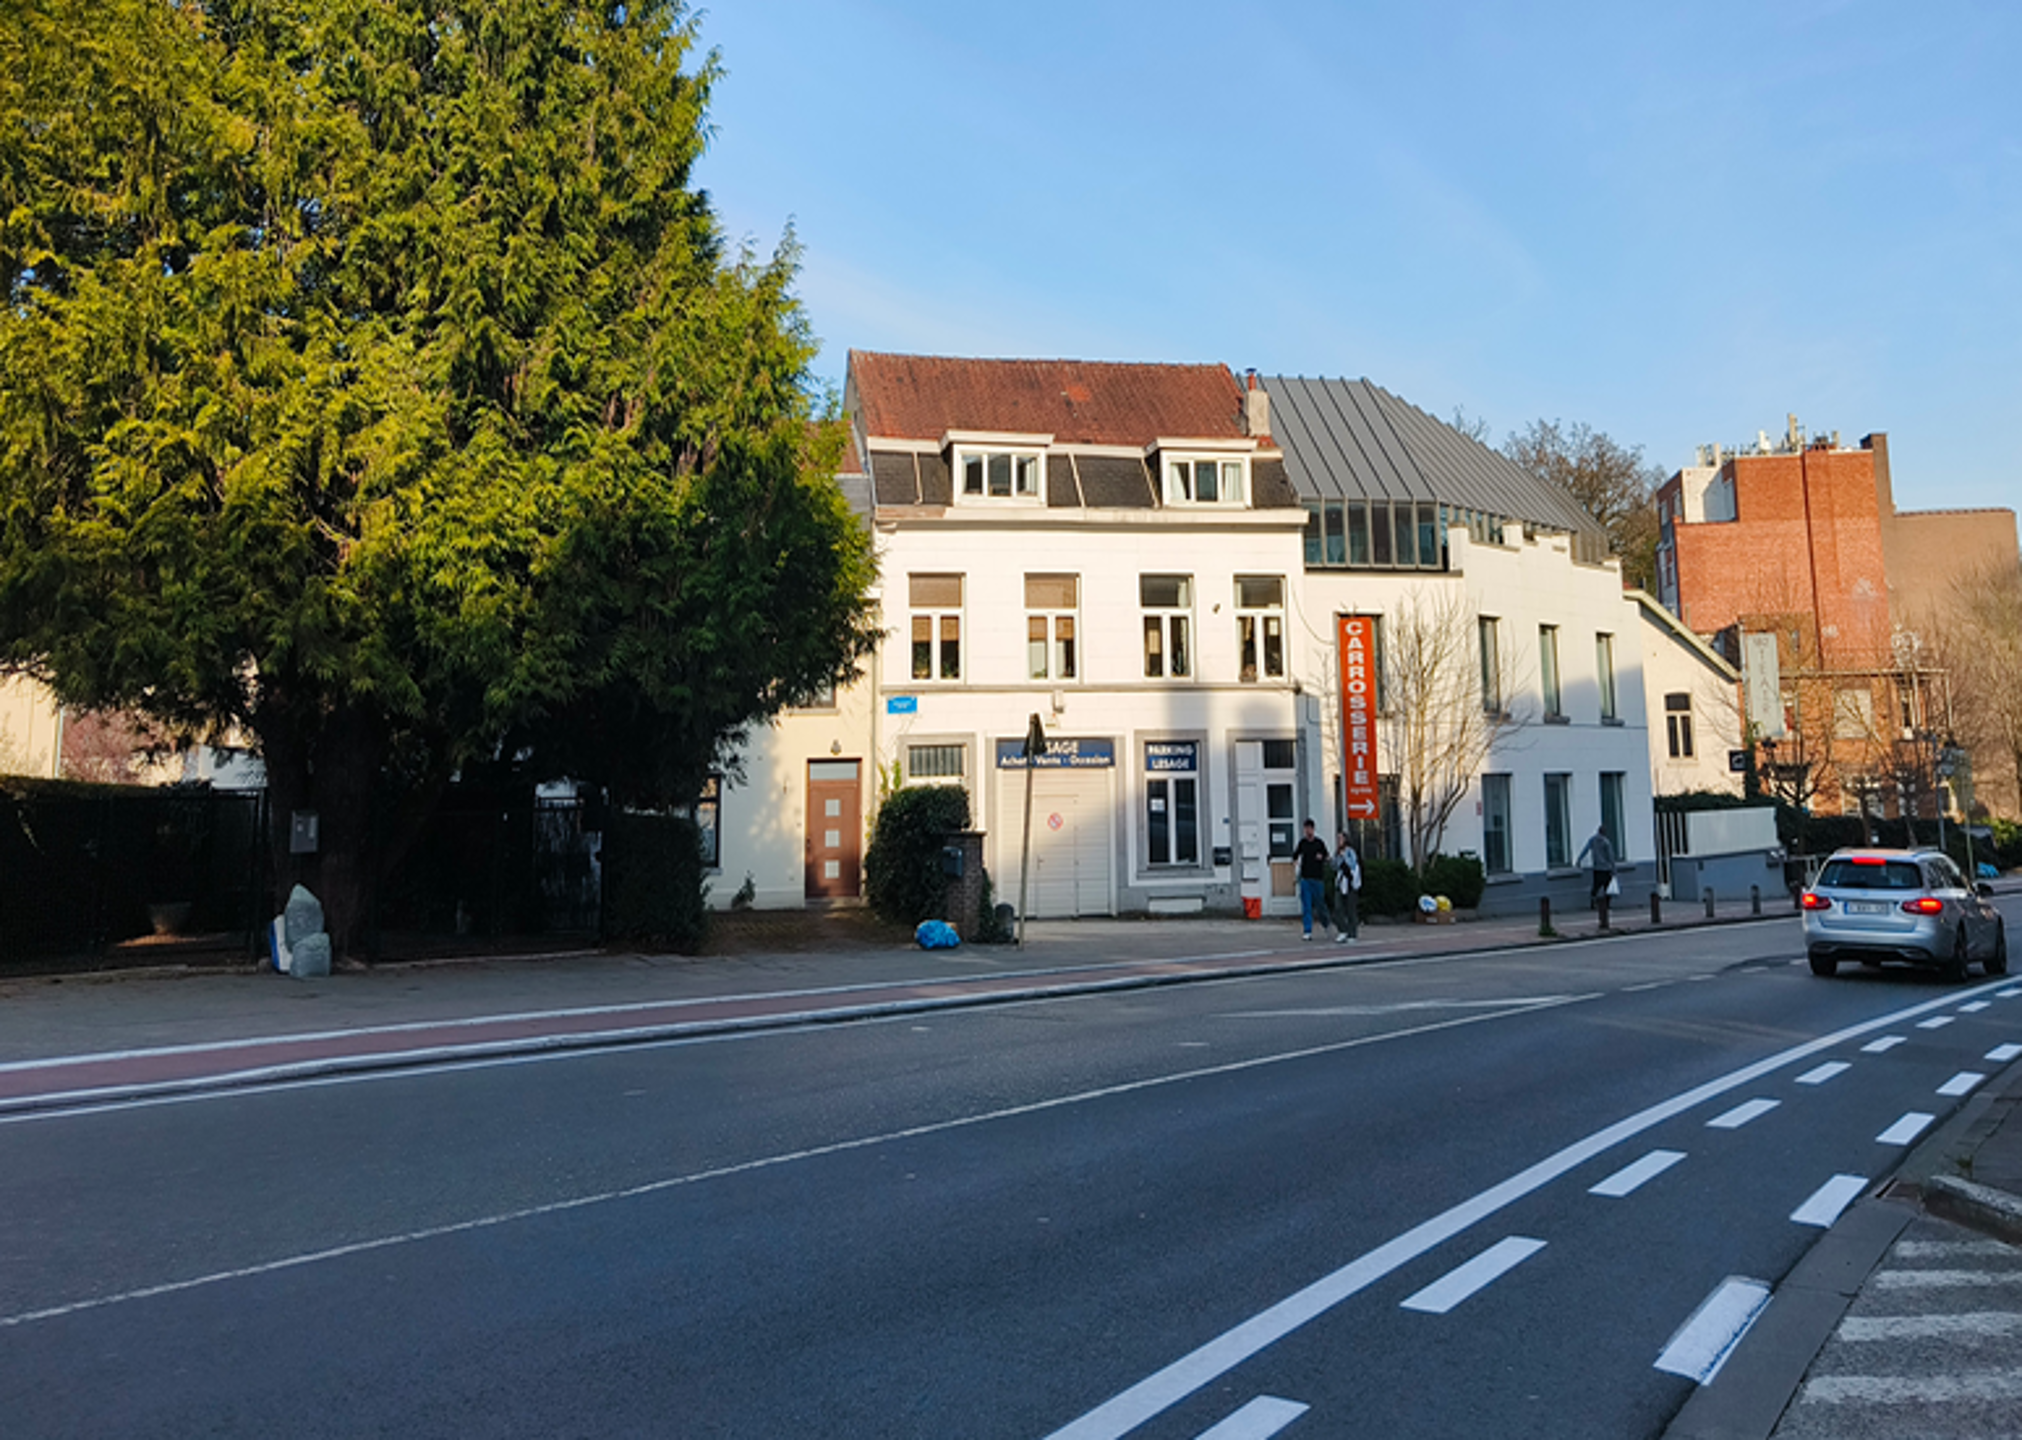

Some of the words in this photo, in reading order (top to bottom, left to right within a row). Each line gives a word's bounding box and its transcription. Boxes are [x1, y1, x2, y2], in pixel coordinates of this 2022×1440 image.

[1345, 621, 1369, 785] CARROSSERIE
[1045, 741, 1078, 754] SAGE
[1148, 744, 1194, 756] PARKING
[1151, 758, 1189, 770] LESAGE
